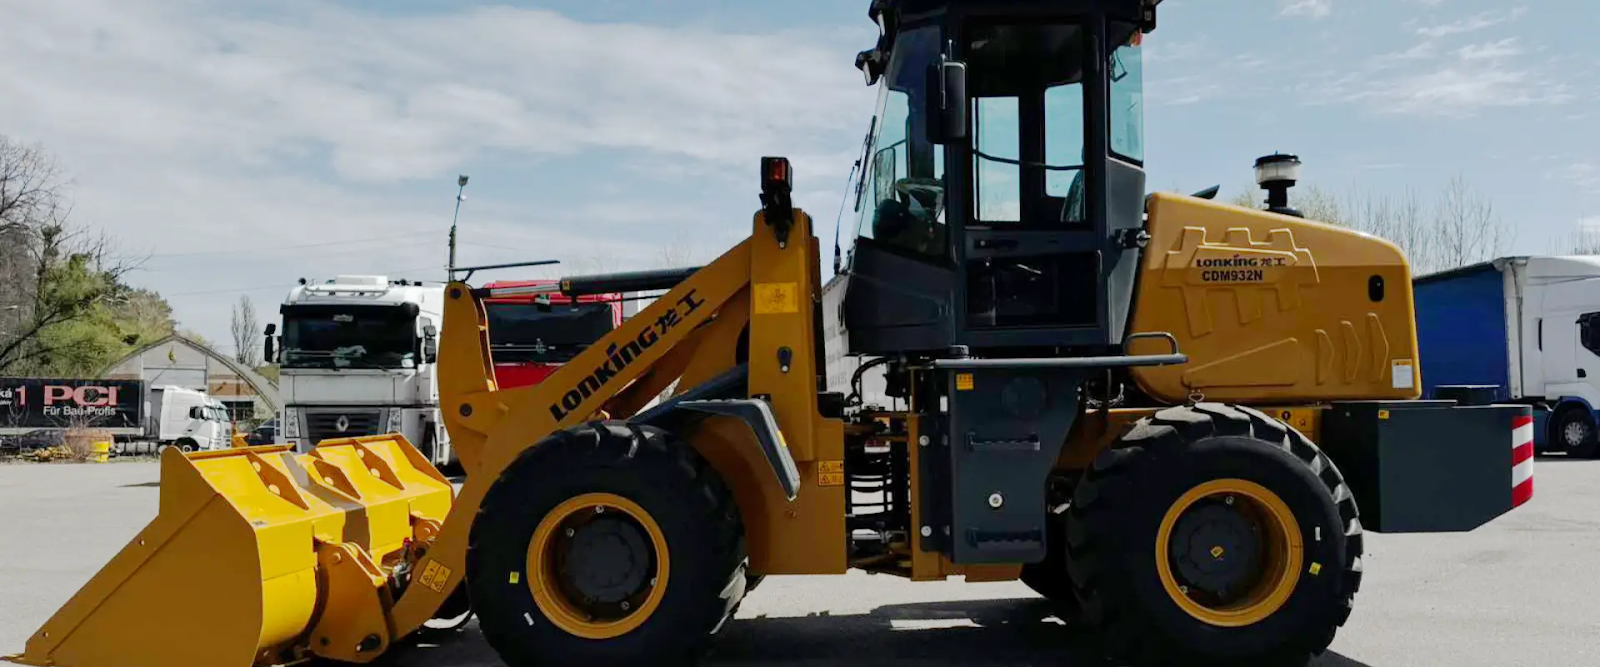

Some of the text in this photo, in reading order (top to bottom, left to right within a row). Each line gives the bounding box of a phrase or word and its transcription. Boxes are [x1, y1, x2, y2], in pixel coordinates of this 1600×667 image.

[1202, 270, 1263, 281] CDM932N
[655, 288, 705, 335] 龙工
[15, 385, 26, 405] 1
[44, 385, 118, 406] PCI
[43, 405, 116, 416] Für Bau-Profis
